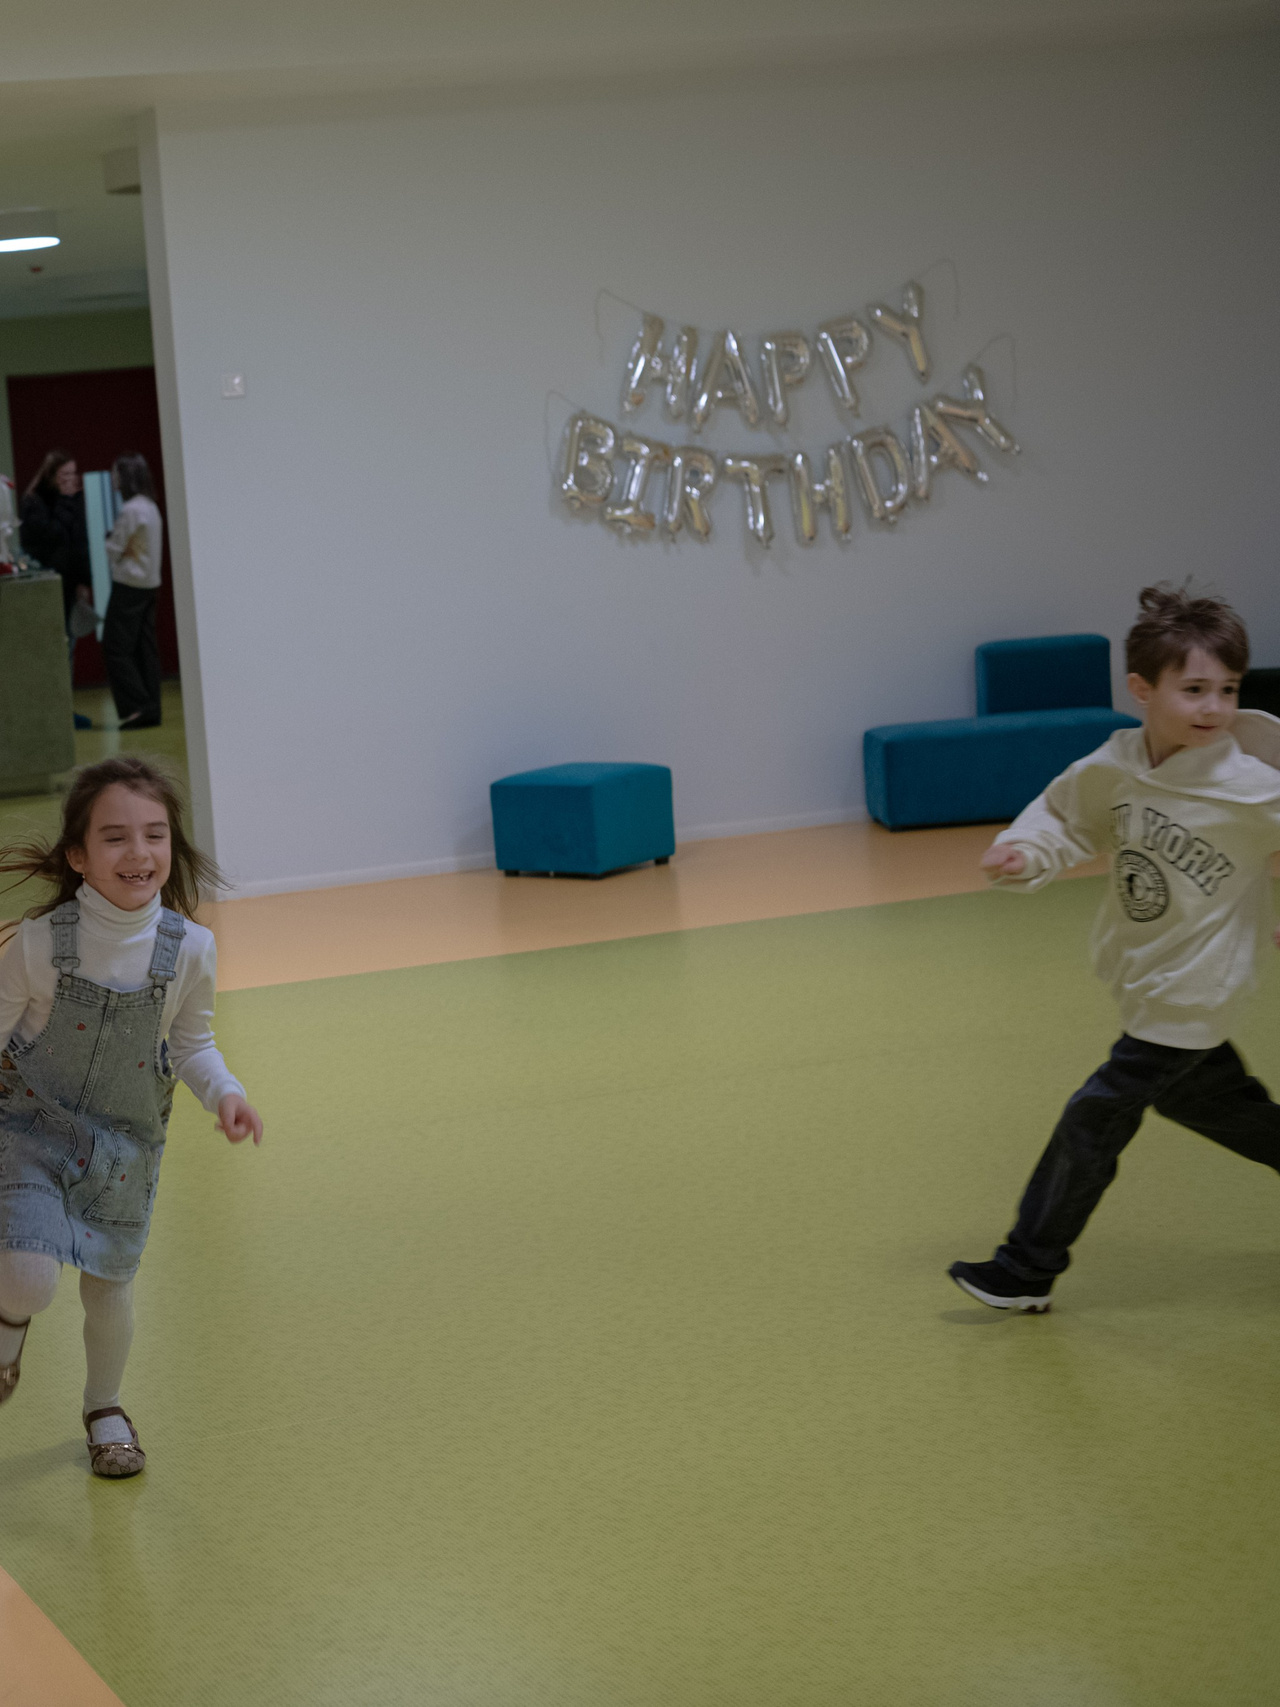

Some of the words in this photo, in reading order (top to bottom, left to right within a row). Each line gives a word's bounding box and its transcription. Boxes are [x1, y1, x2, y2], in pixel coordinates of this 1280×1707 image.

[622, 281, 928, 430] HAPPY
[561, 366, 1021, 546] BIRTHDAY
[1141, 806, 1236, 896] YORK
